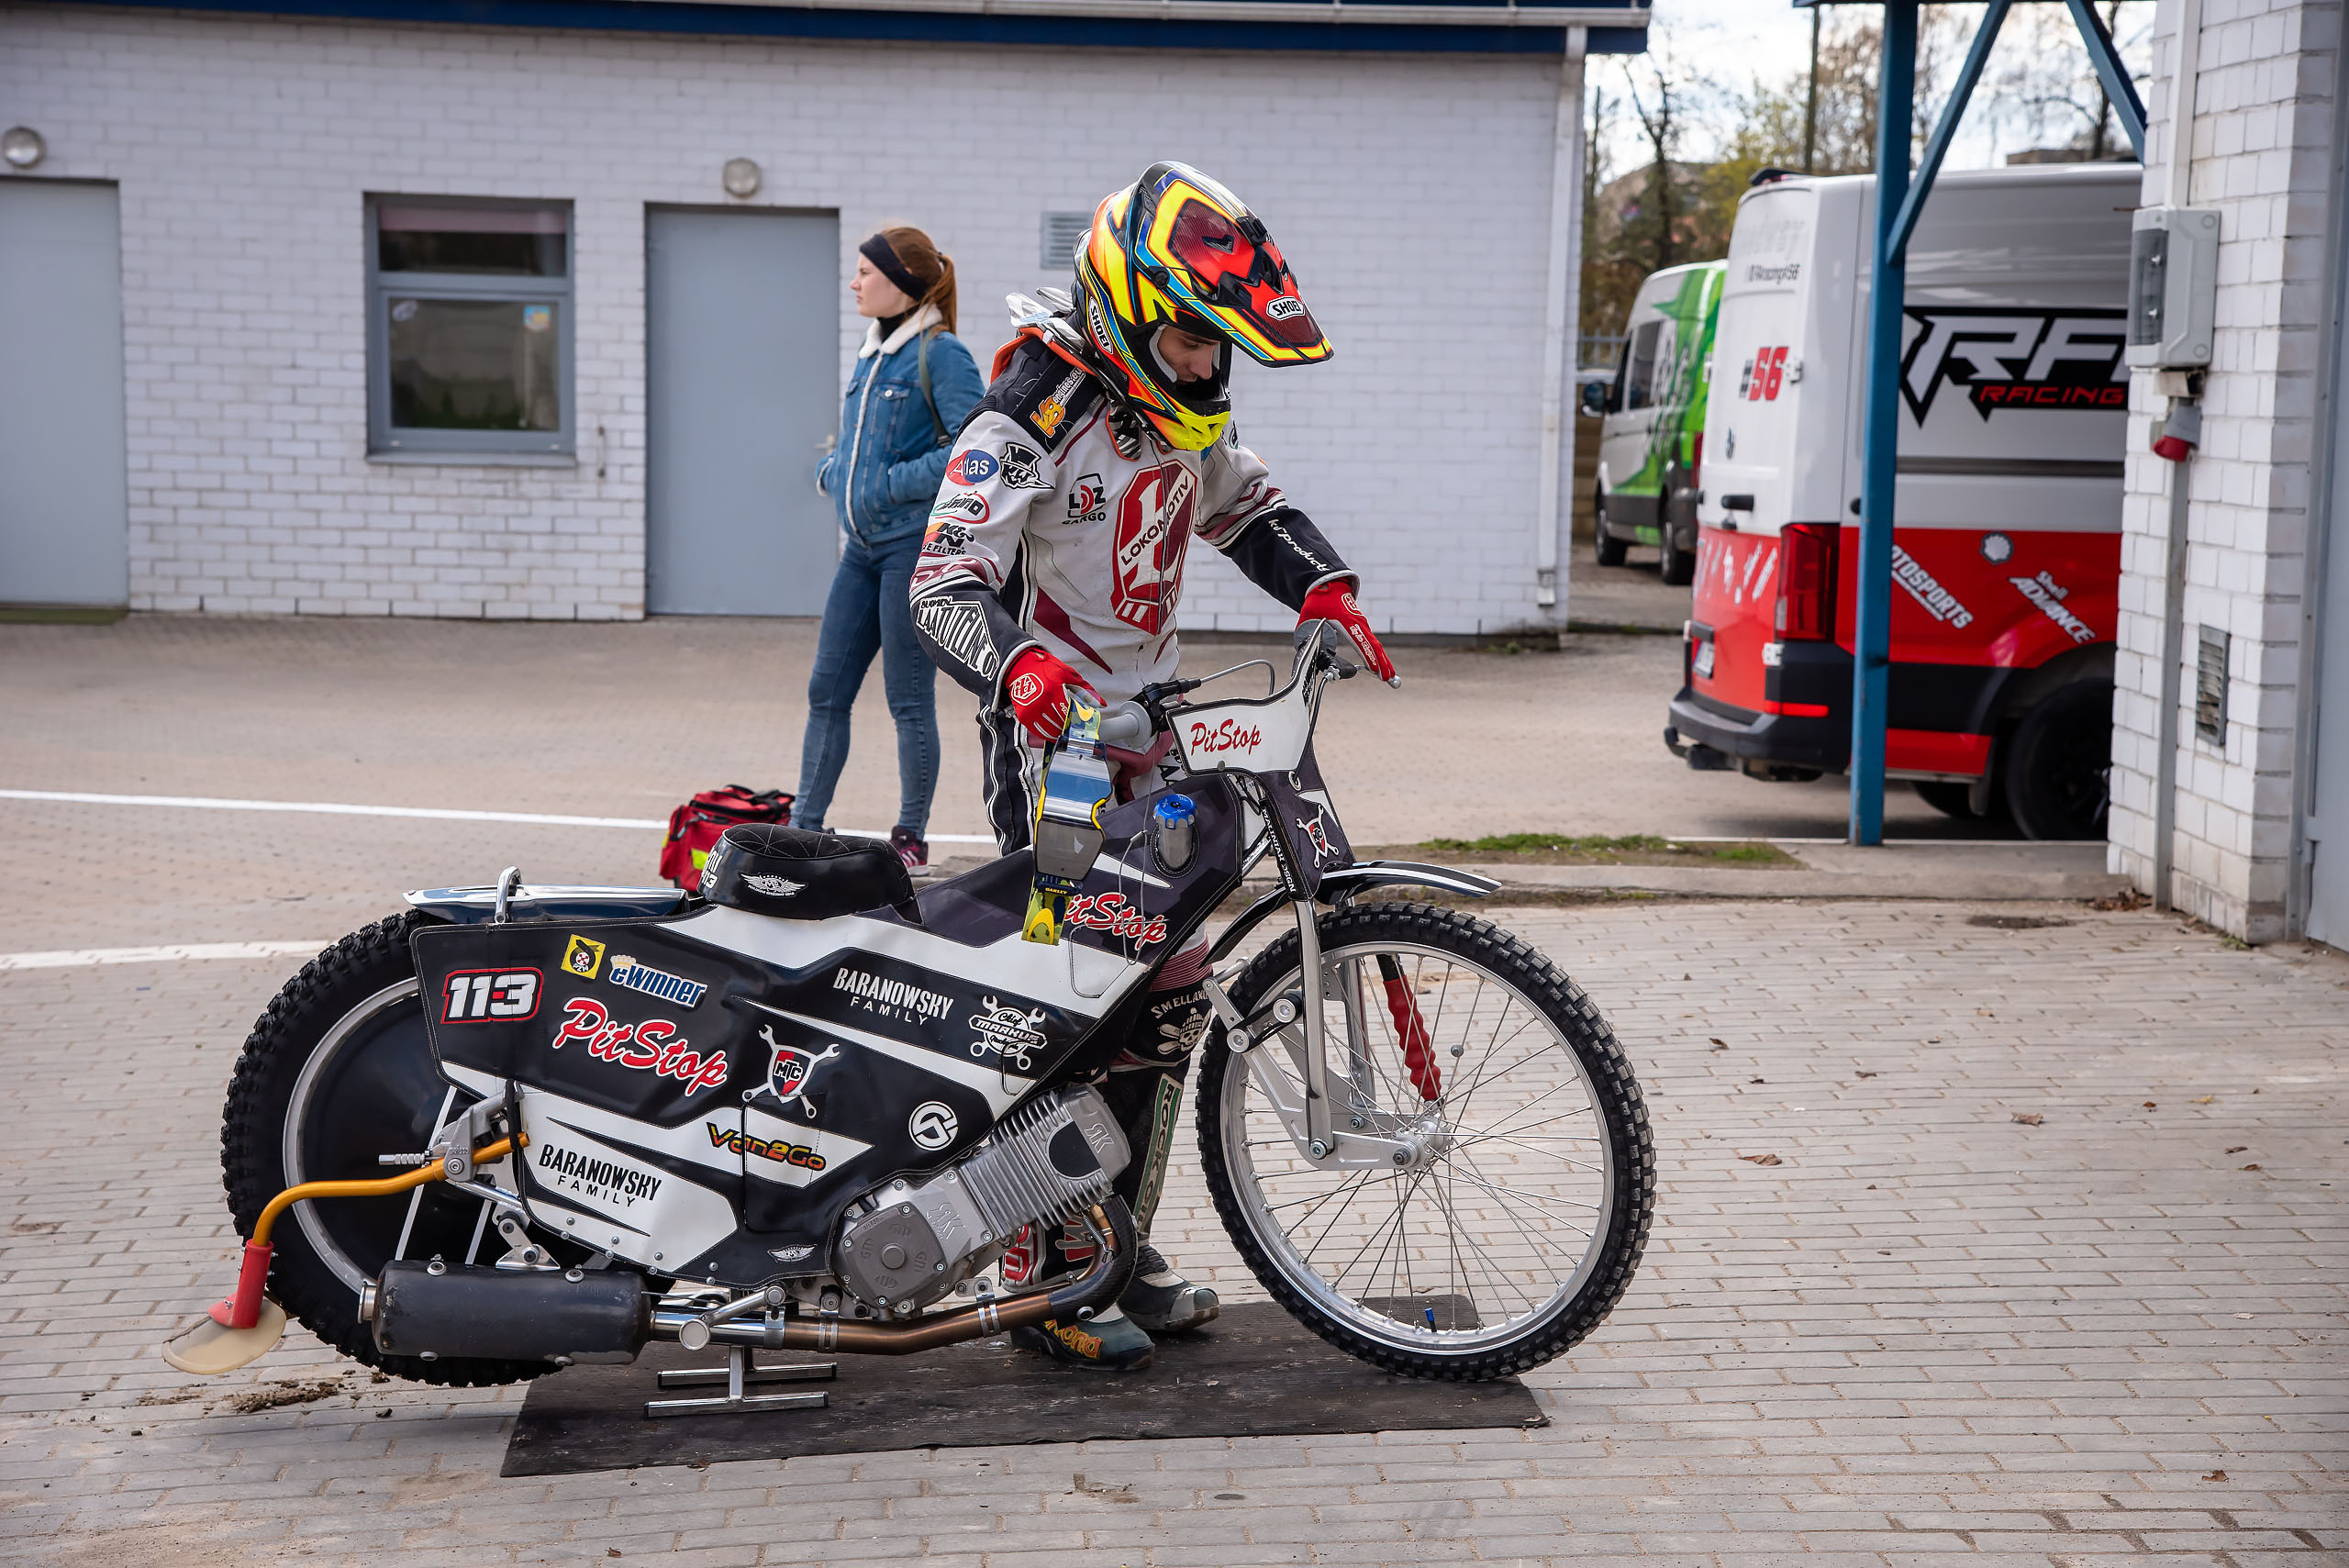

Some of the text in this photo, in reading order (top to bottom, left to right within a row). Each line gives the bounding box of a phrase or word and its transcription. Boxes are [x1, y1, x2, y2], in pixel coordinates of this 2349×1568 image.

[1090, 305, 1110, 348] SHOEI
[1272, 300, 1302, 317] SHOEI
[1738, 346, 1789, 401] #56
[1979, 385, 2124, 404] RACING
[1062, 512, 1107, 525] CARGO
[1891, 543, 1975, 630] OTOSPORTS
[2008, 576, 2097, 644] ADVANCE
[1190, 718, 1263, 756] PitStop
[1044, 886, 1068, 895] OAKLEY
[1064, 892, 1167, 951] itStop
[446, 973, 539, 1019] 113
[832, 967, 954, 1020] BARANOWSKY
[850, 996, 929, 1026] FAMILY
[552, 996, 728, 1096] PitStop
[975, 1018, 1041, 1045] MARKUS
[774, 1059, 804, 1084] MTC
[706, 1122, 827, 1172] Van2Go
[1151, 1083, 1175, 1172] ROCK
[538, 1143, 662, 1202] BARANOWSKY
[557, 1174, 636, 1207] FAMILY
